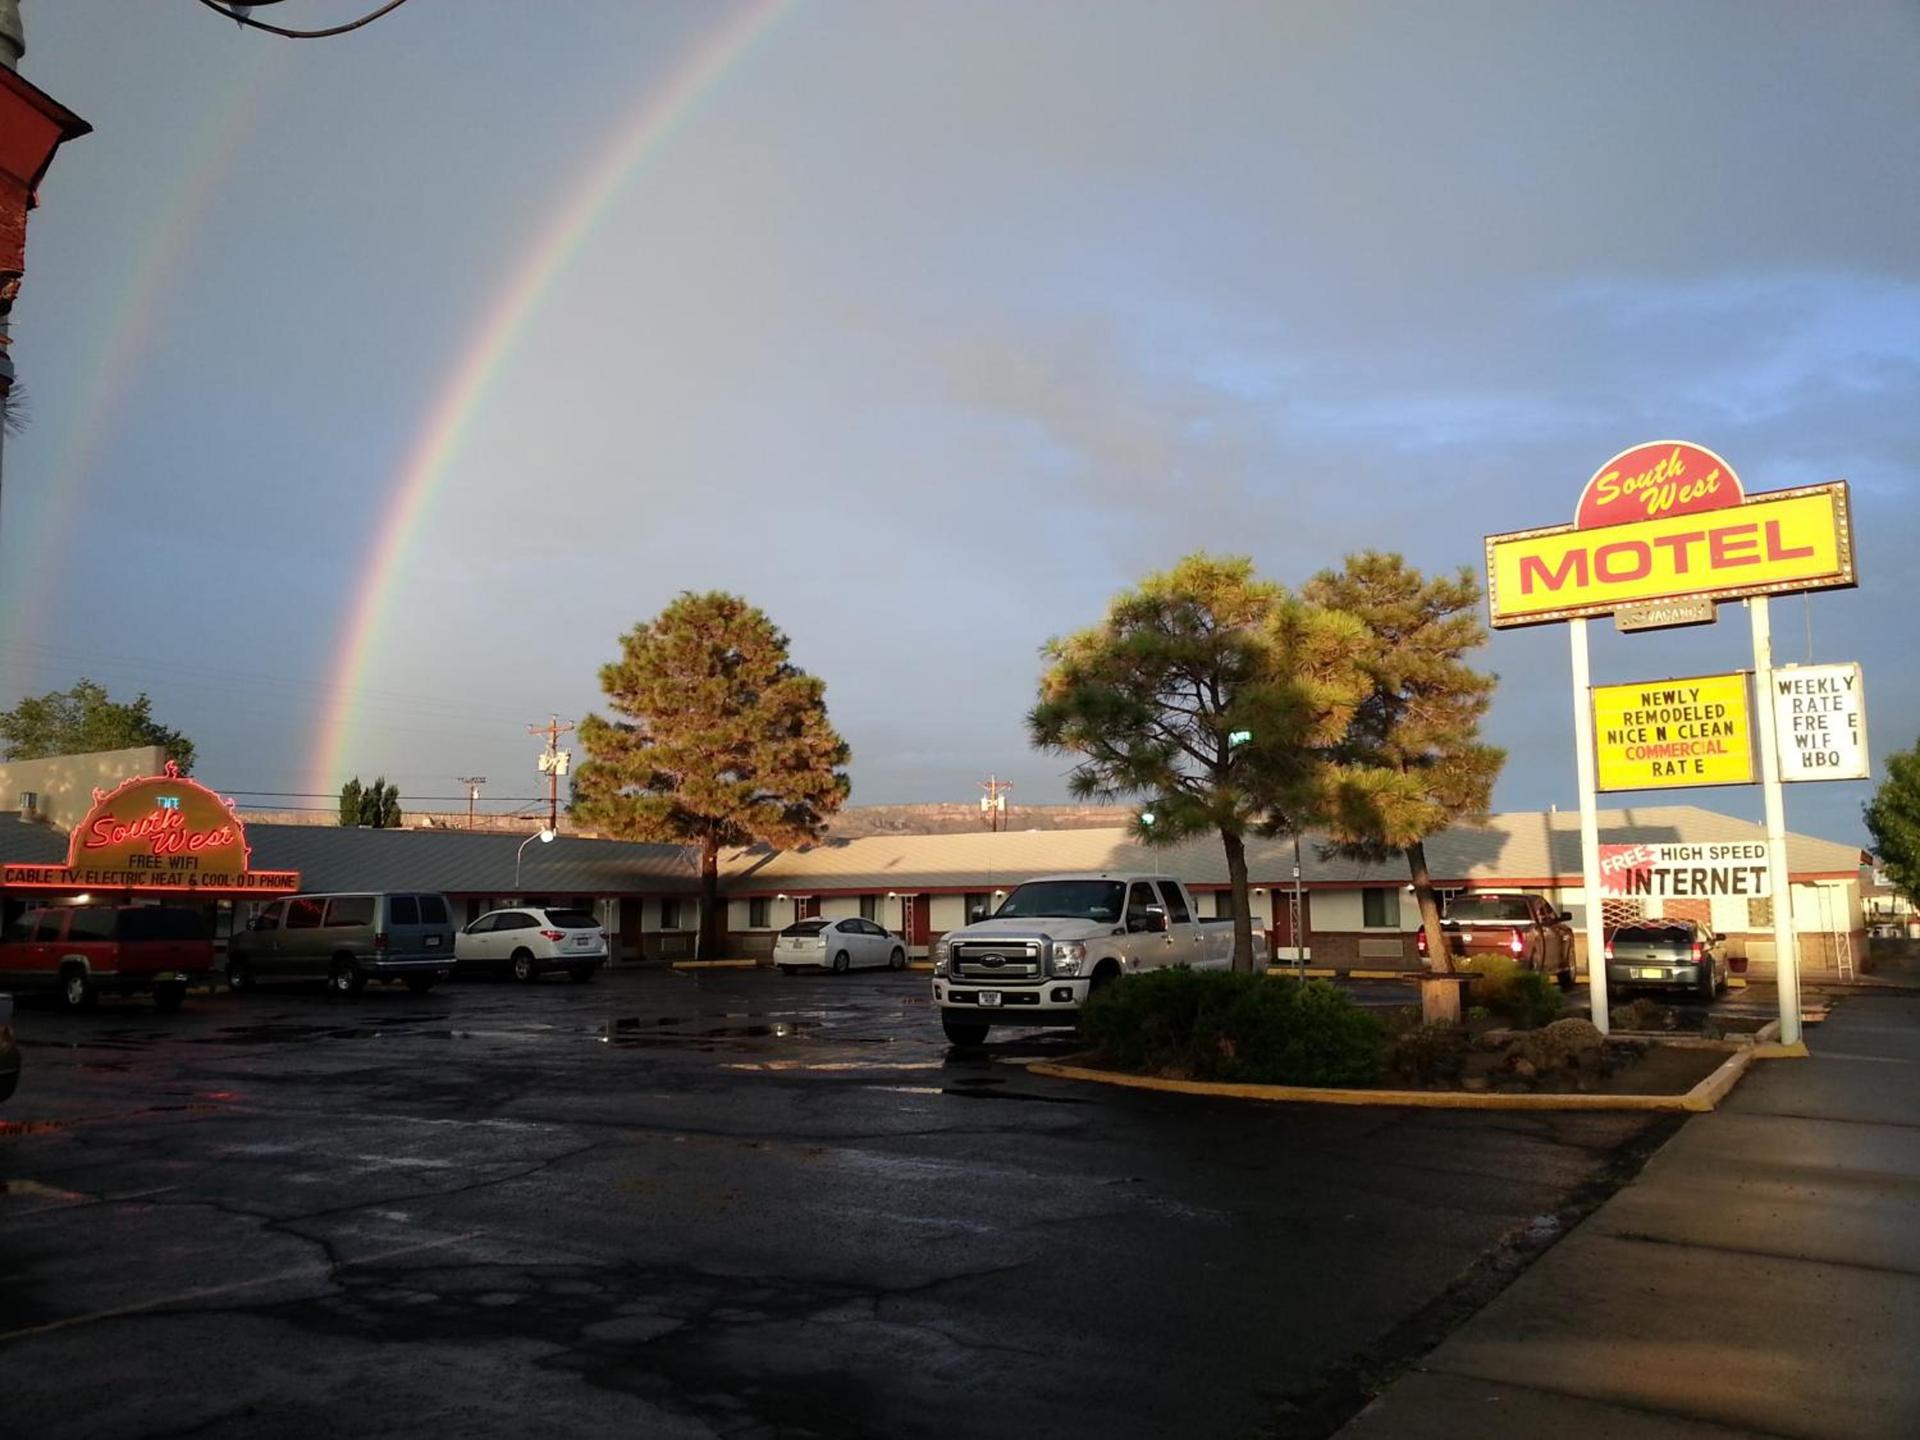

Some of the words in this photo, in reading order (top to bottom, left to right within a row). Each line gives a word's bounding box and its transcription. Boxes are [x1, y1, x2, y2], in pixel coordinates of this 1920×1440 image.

[1595, 447, 1685, 507] South
[1640, 468, 1720, 515] West
[1519, 520, 1815, 595] MOTEL
[1778, 676, 1855, 695] WEEKLY
[1641, 688, 1700, 707] NEWLY
[1793, 695, 1843, 714] RATE
[1623, 704, 1725, 726] REMODELED
[1607, 729, 1647, 744] NICE
[1656, 727, 1667, 742] N
[1678, 721, 1734, 739] CLEAN
[1625, 740, 1728, 761] COMMERCIAL
[1652, 758, 1704, 777] RATE
[85, 810, 184, 848] South
[150, 825, 235, 854] West
[128, 855, 162, 869] FREE
[169, 857, 199, 870] WIFI
[1602, 847, 1647, 875] FREE
[1661, 847, 1703, 861] HIGH
[1709, 845, 1765, 860] SPEED
[5, 868, 53, 884] CABLE
[151, 872, 184, 886] HEAT
[188, 873, 198, 886] &
[260, 874, 297, 888] PHONE
[1626, 866, 1767, 896] INTERNET
